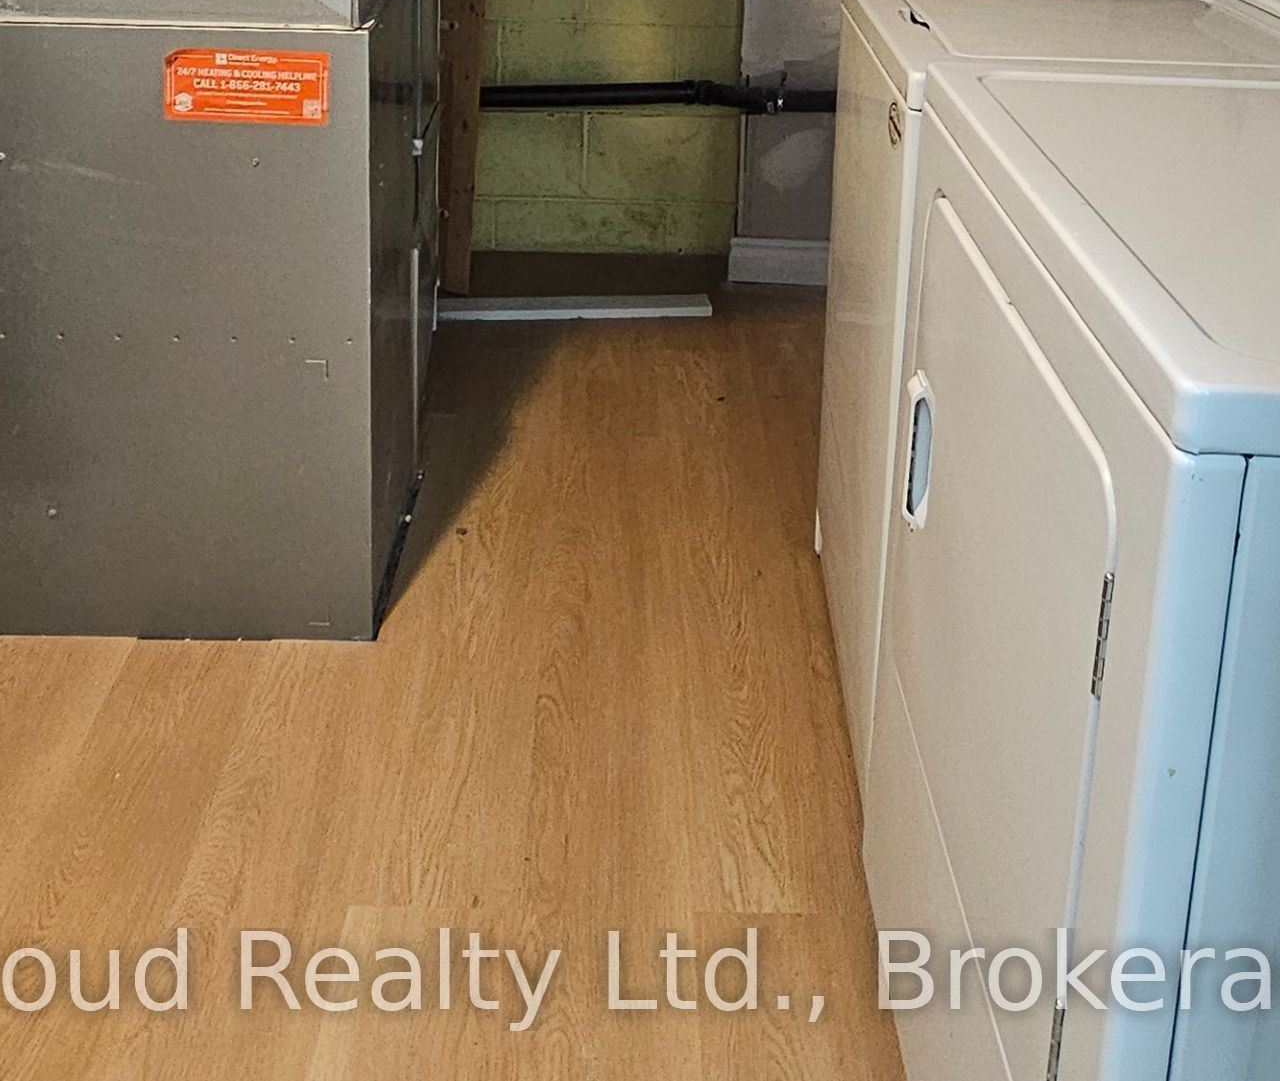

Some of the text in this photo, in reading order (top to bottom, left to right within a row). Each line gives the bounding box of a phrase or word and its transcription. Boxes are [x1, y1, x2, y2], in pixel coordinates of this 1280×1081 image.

[227, 54, 279, 64] Direct Energy
[176, 67, 318, 81] 24/7 HEATING & COOLING HELPLINE
[193, 78, 218, 89] CALL
